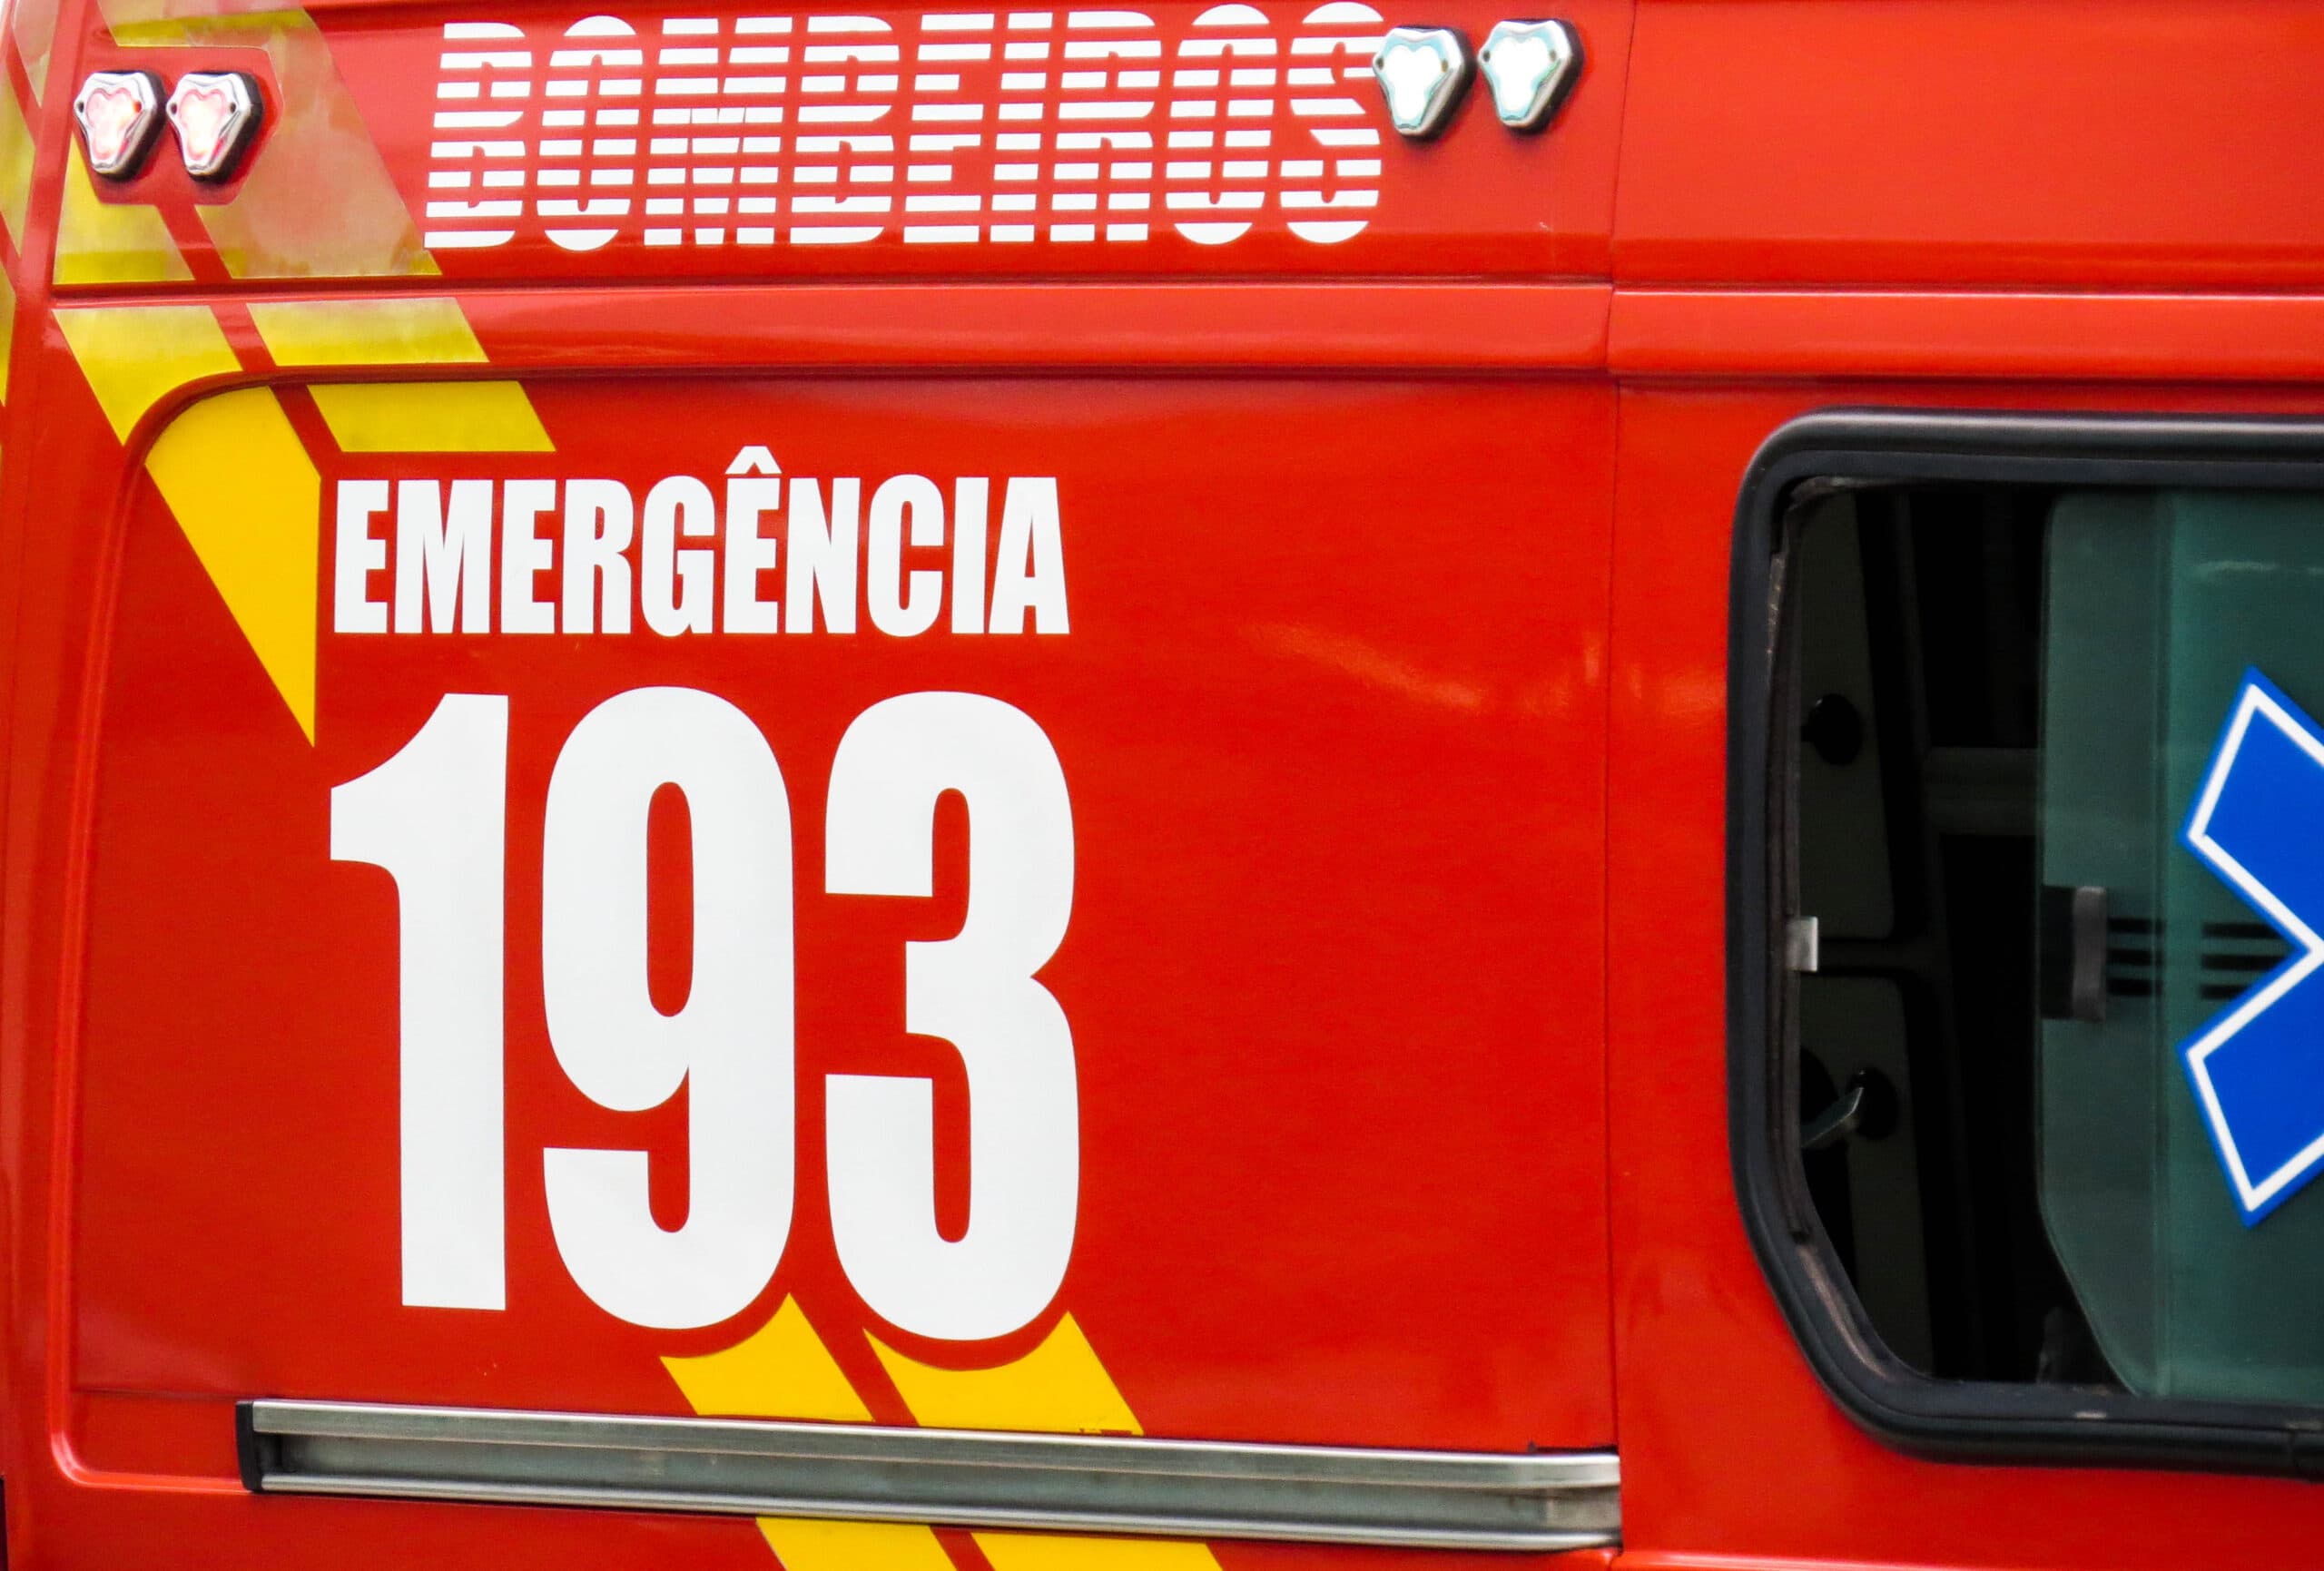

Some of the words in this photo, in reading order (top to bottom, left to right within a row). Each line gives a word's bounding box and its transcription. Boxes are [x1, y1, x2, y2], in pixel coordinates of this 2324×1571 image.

[424, 2, 1384, 251] BOMBEIROS
[334, 446, 1070, 637] EMERGÊNCIA
[330, 686, 1079, 1340] 193
